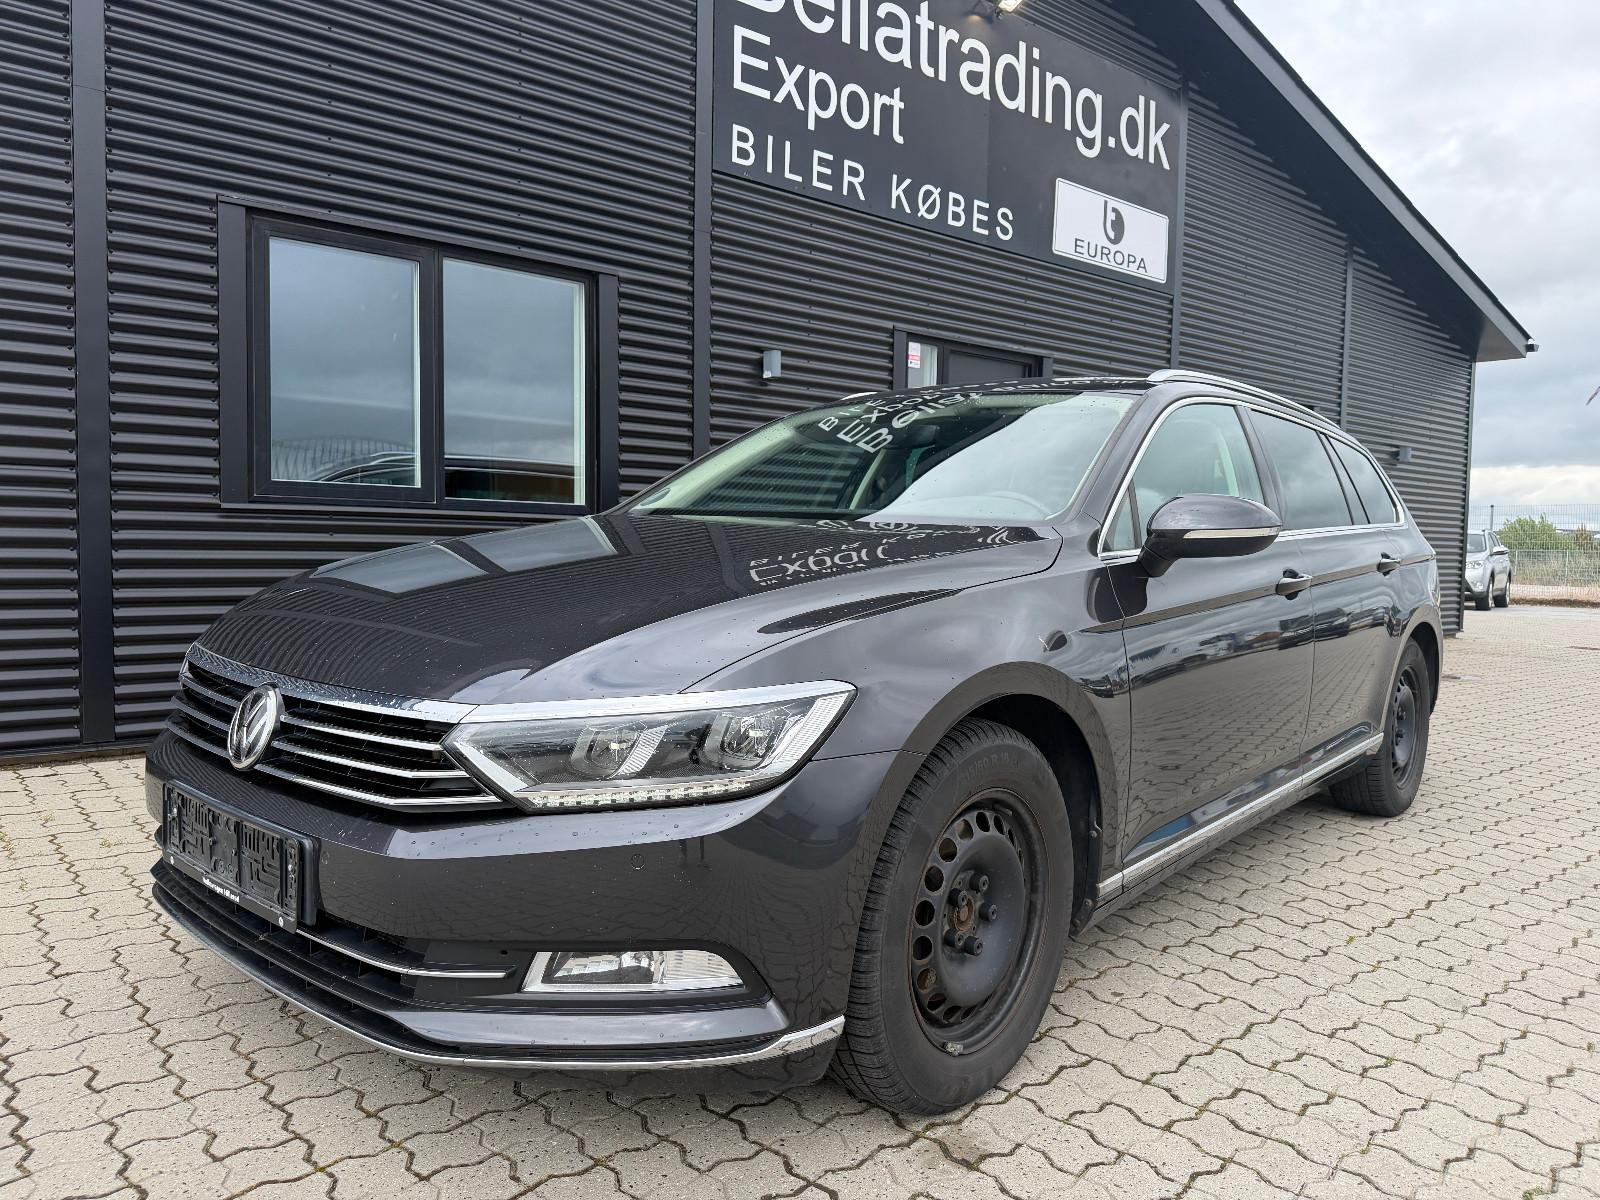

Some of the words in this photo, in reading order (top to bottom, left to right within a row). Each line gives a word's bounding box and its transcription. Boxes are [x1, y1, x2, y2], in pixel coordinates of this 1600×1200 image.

[733, 24, 906, 145] Export
[737, 0, 1172, 171] ellatrading.dk
[731, 123, 867, 201] BILER
[891, 174, 1014, 241] KØBES
[1074, 237, 1148, 273] EUROPA
